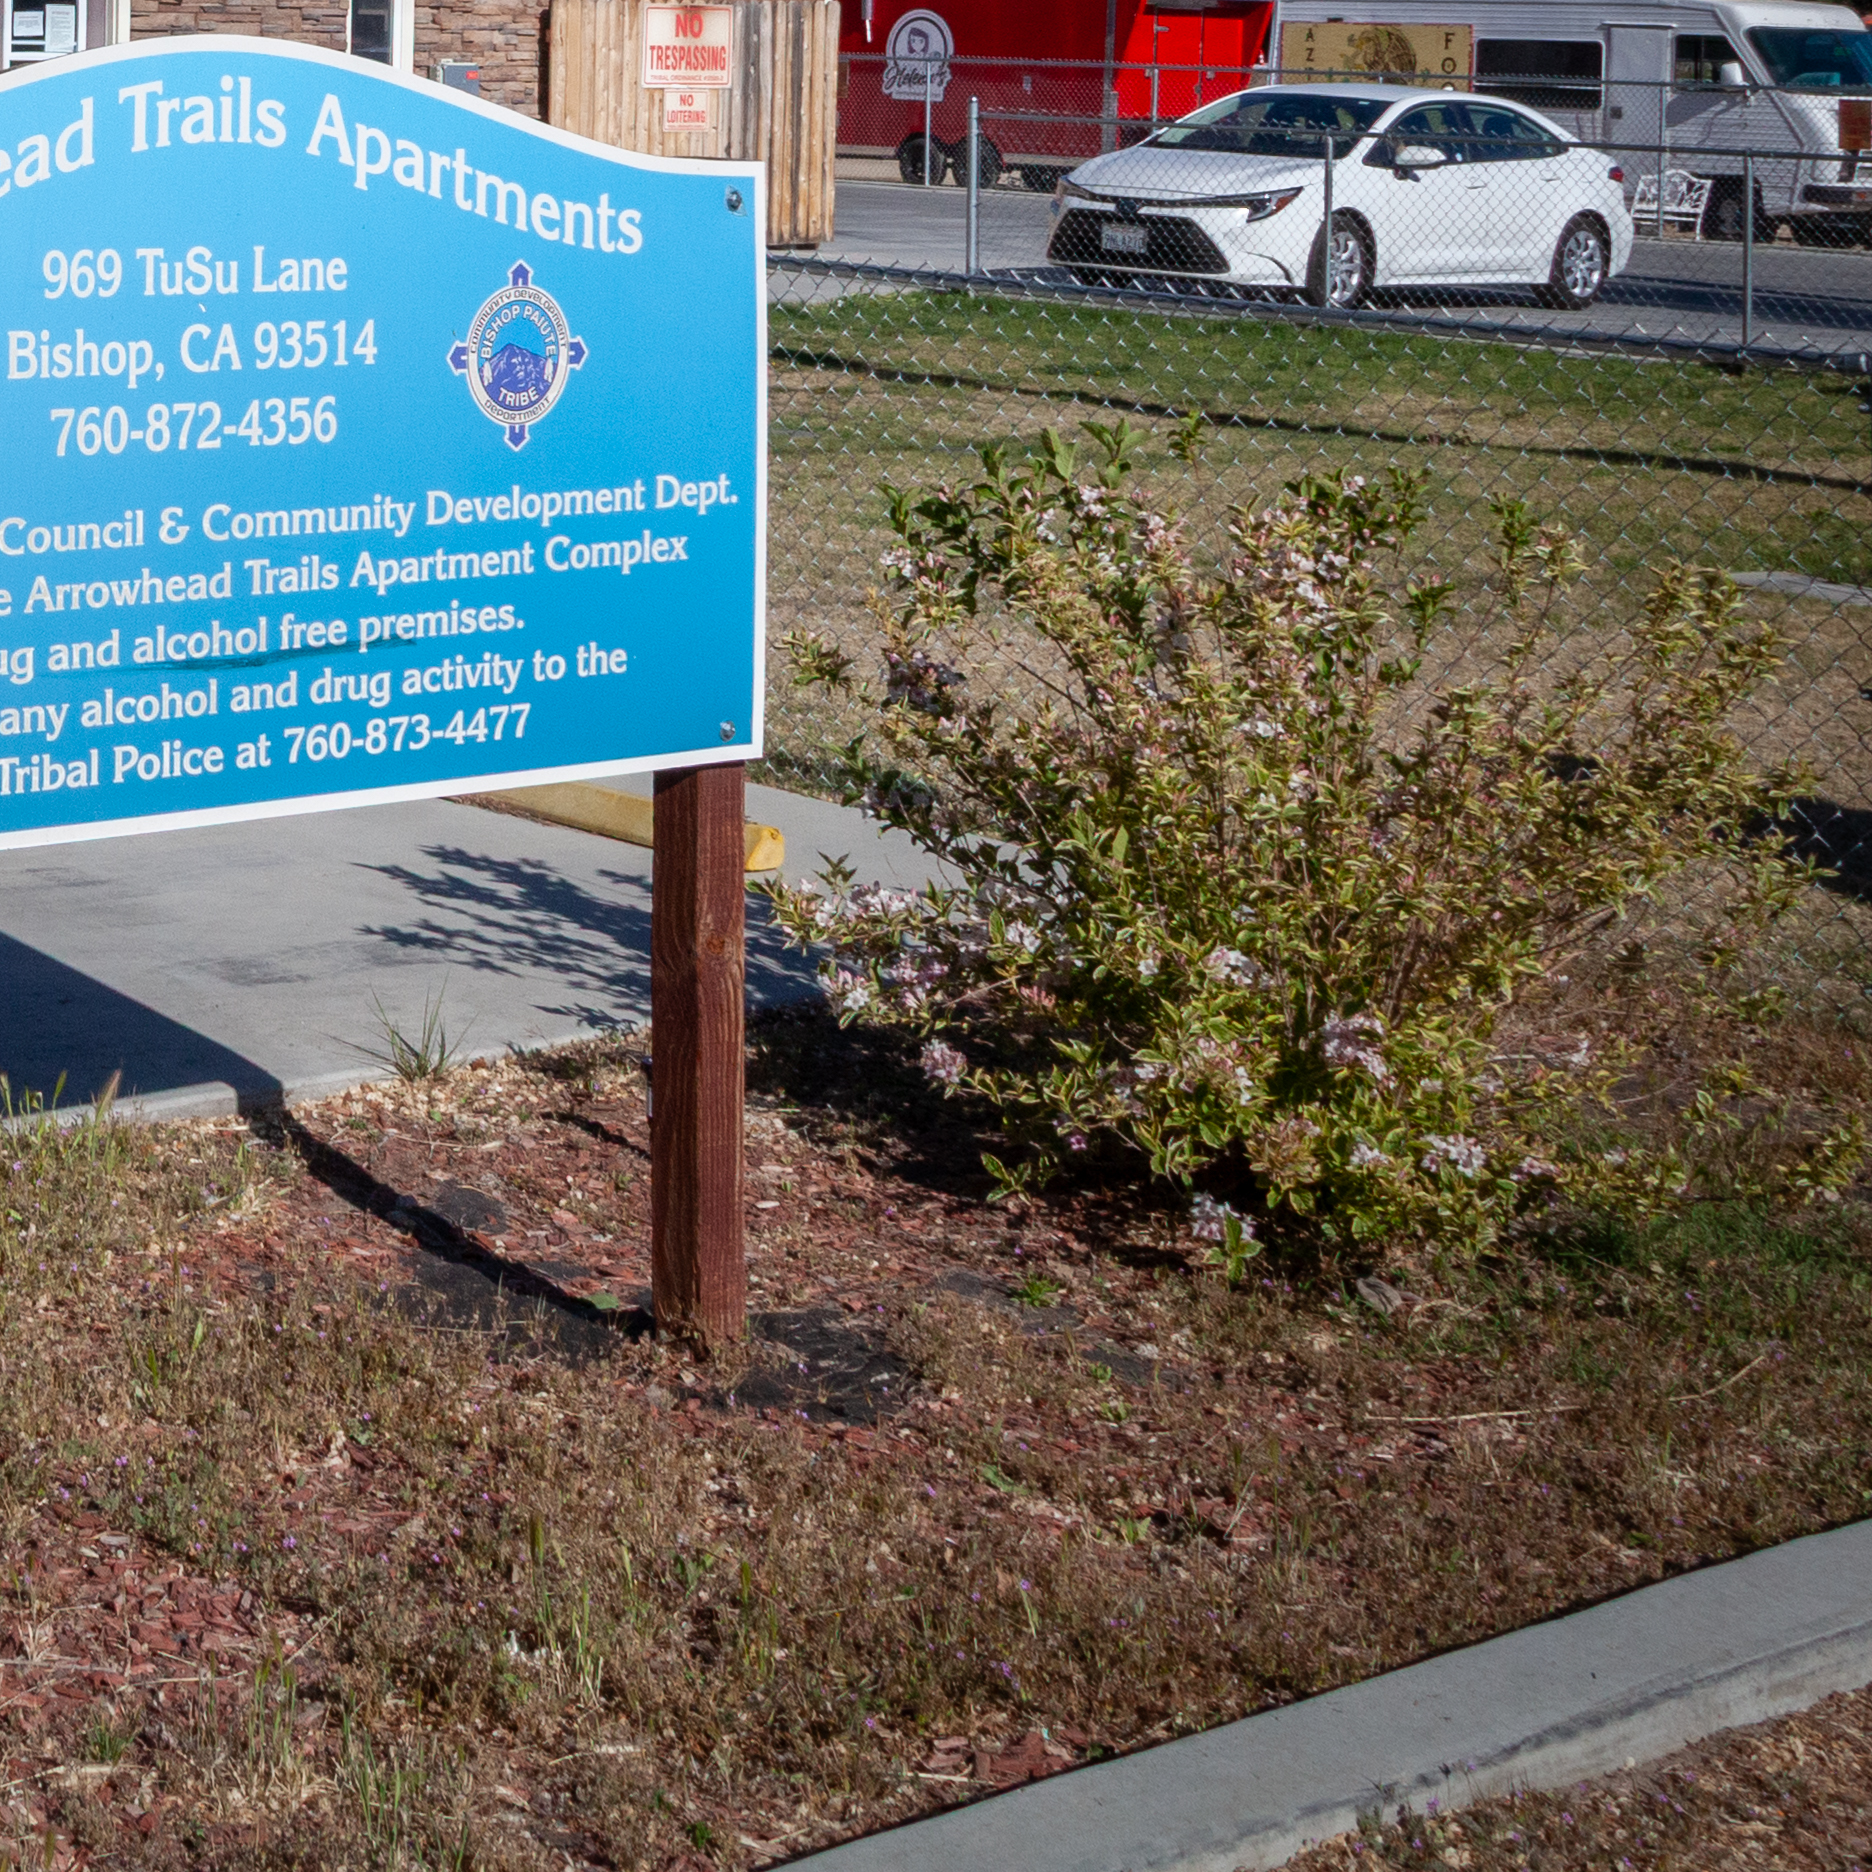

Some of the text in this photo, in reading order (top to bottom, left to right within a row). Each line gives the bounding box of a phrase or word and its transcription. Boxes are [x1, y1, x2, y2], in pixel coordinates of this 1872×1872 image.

[675, 13, 704, 39] NO
[649, 45, 727, 72] TRESPASSING
[666, 110, 706, 123] LOITERING
[679, 94, 694, 106] NO
[118, 75, 287, 152] Trails
[306, 93, 643, 254] Apartments
[42, 245, 348, 299] 969 TuSu Lane
[7, 319, 377, 389] Bishop, CA 93514
[481, 304, 557, 359] BISHOP PAIUTE
[50, 395, 337, 457] 760-872-4356
[498, 386, 539, 407] TRIBE
[159, 506, 190, 544] &
[202, 494, 415, 541] Community
[426, 480, 645, 527] Development
[656, 474, 739, 515] Dept.
[24, 562, 231, 614] Arrowhead
[244, 555, 339, 595] Trails
[350, 542, 534, 595] Apartment
[545, 530, 687, 574] Complex
[48, 629, 120, 671] and
[132, 616, 267, 663] alcohol
[280, 613, 347, 650] free
[359, 599, 524, 653] premises.
[81, 679, 217, 727] alcohol
[230, 671, 297, 712] and
[310, 667, 390, 708] drug
[402, 652, 523, 695] activity
[533, 650, 566, 681] to
[577, 641, 627, 677] the
[113, 739, 224, 783] Police
[236, 734, 271, 769] at
[284, 702, 530, 763] 760-873-4477
